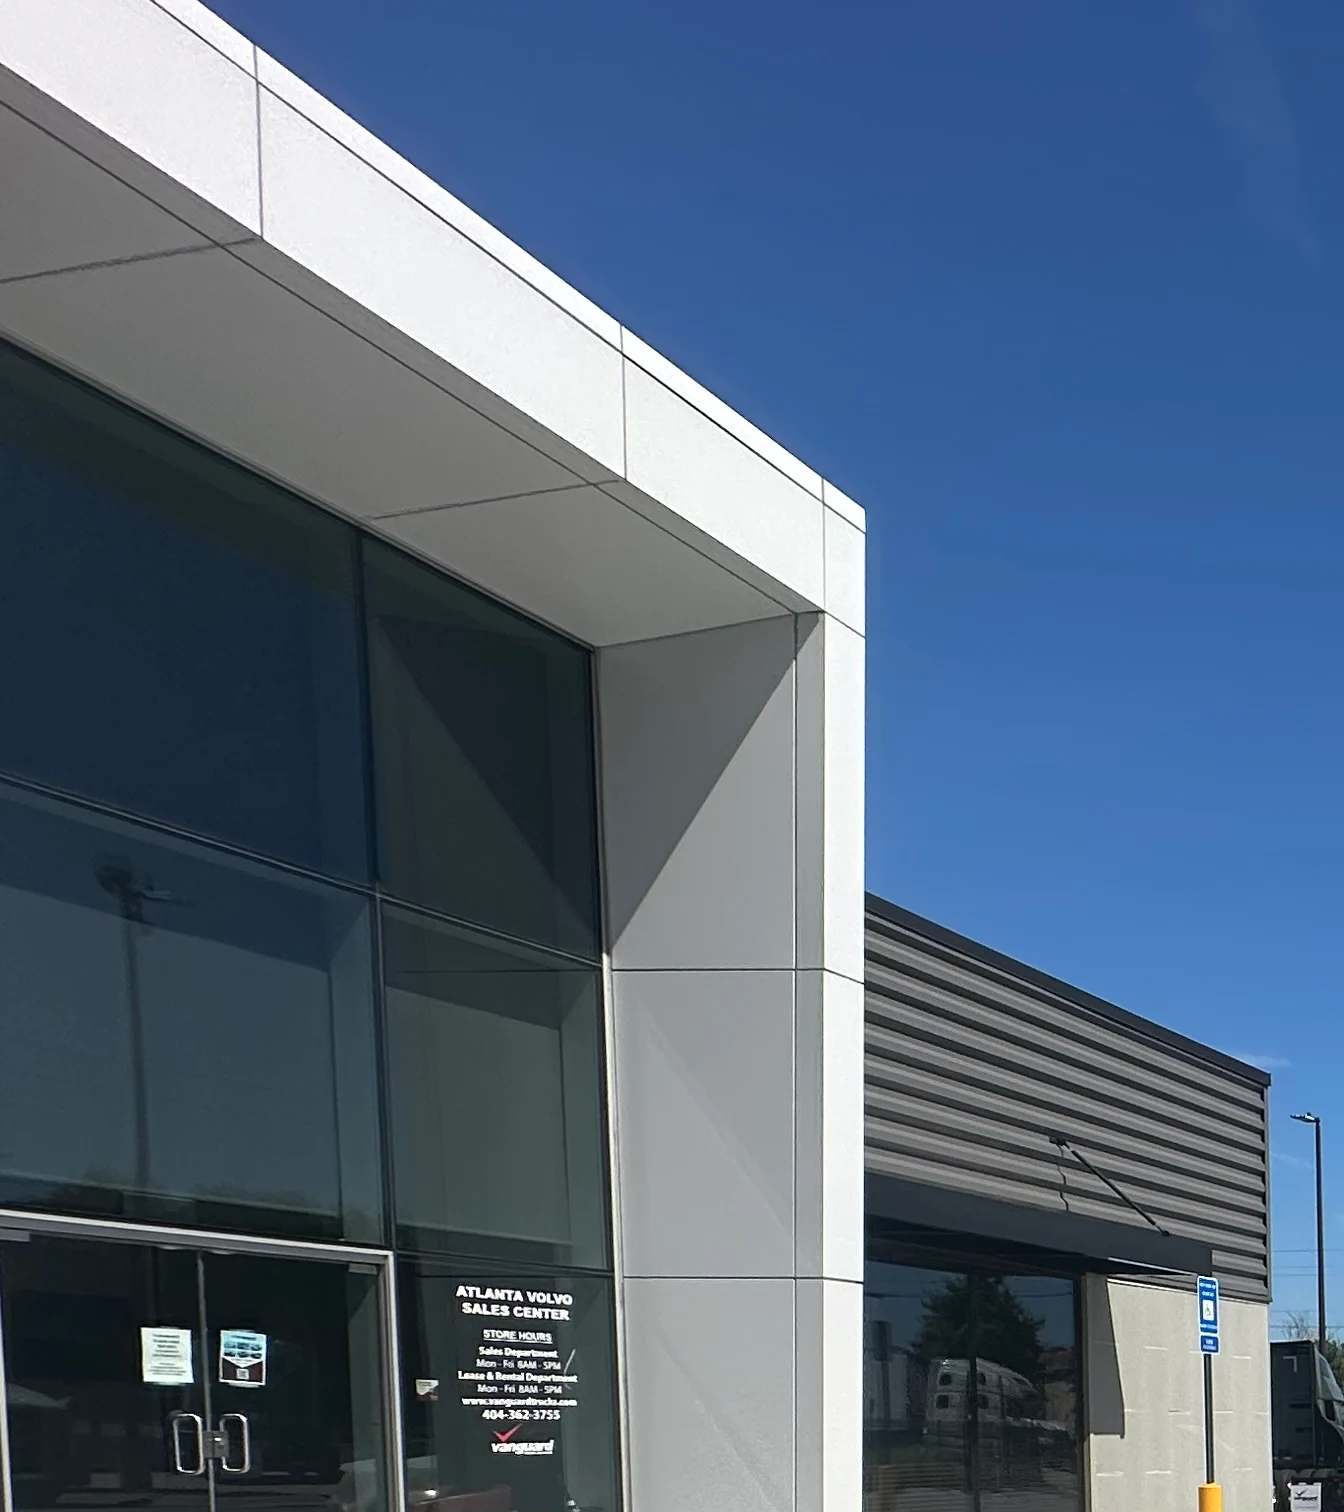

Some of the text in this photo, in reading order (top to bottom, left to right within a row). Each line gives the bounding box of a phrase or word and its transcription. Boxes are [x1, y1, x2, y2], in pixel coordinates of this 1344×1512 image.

[456, 1285, 573, 1306] ATLANTA VOLVO
[462, 1302, 570, 1321] SALES CENTER
[483, 1329, 552, 1343] STORE HOURS
[478, 1346, 558, 1359] Sales Department
[476, 1359, 497, 1368] Mon
[503, 1360, 515, 1369] Fri
[458, 1370, 578, 1384] Lease & Rental Department
[477, 1384, 498, 1393] Mon
[504, 1384, 516, 1393] Fri
[481, 1409, 561, 1420] 404-362-3755
[491, 1439, 554, 1455] vanguard
